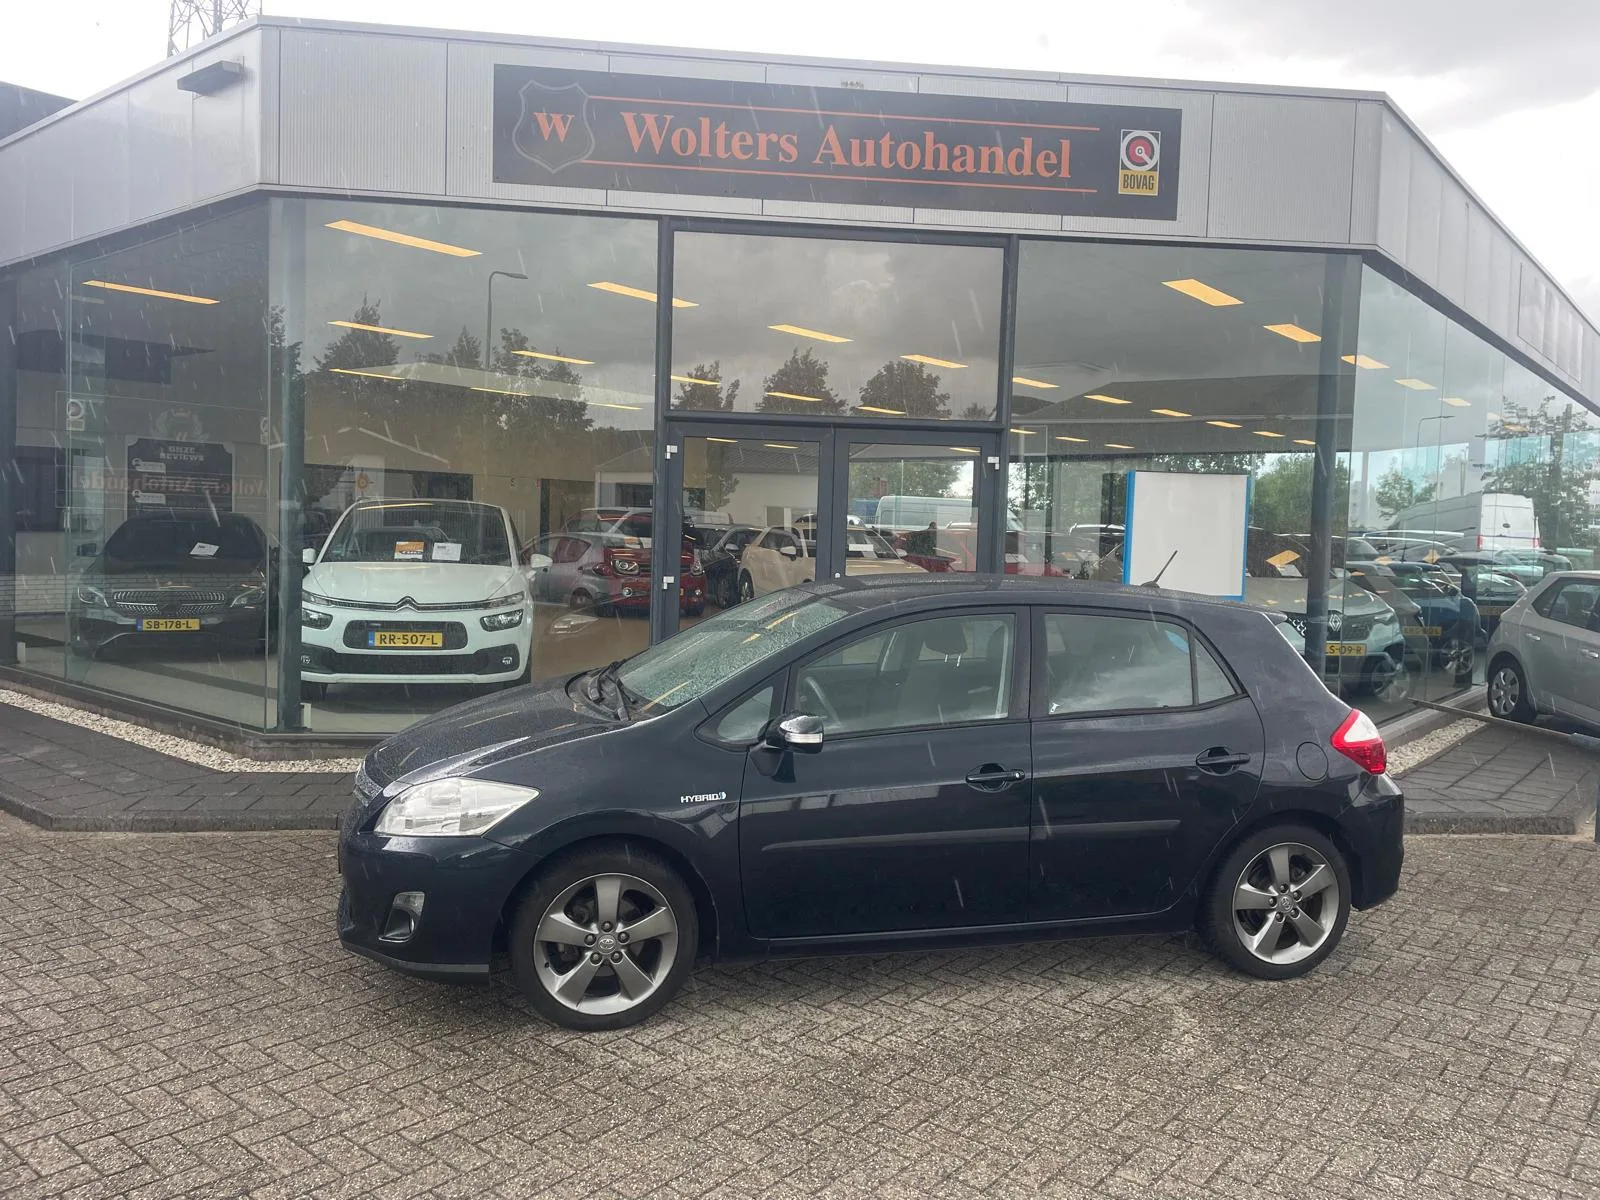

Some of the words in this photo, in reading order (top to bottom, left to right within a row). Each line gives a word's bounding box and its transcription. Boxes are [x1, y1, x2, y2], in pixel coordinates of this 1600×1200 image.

[533, 112, 575, 143] W
[620, 111, 798, 163] Wolters
[812, 125, 1071, 178] Autohandel
[1123, 173, 1155, 191] BOVAG
[146, 620, 193, 629] SB-178-L
[379, 634, 438, 645] RR-507-L
[1328, 645, 1362, 654] S-09-R
[680, 793, 719, 803] HYBRID
